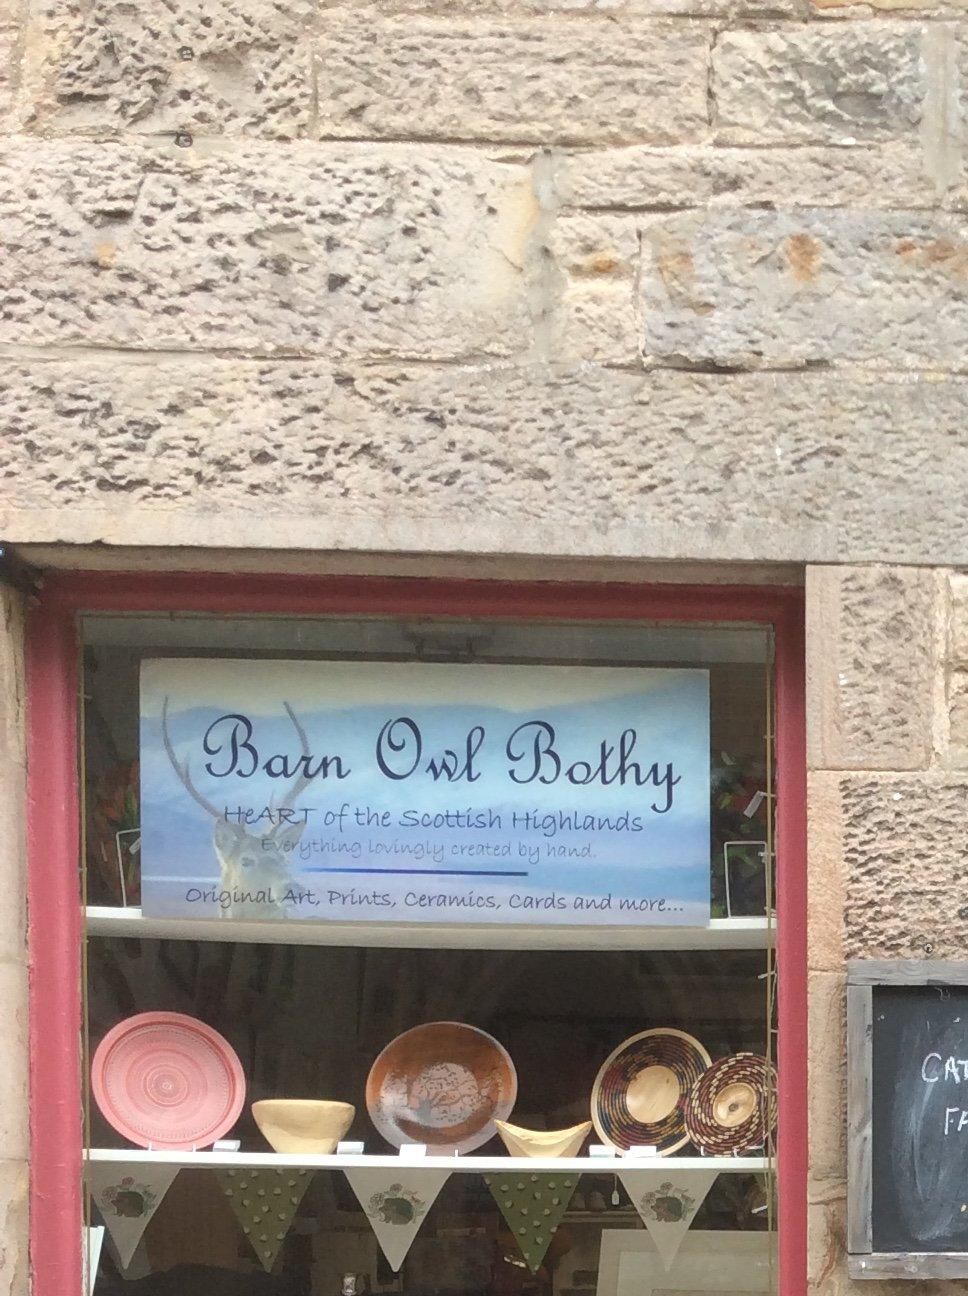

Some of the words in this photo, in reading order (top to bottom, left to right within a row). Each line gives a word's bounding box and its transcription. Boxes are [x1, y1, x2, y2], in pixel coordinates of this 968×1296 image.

[203, 714, 351, 779] Barn
[375, 717, 485, 782] Owl
[506, 720, 681, 813] Bothy
[224, 806, 317, 825] HeART
[324, 803, 350, 832] of
[356, 806, 392, 827] the
[398, 806, 502, 829] Scottish
[512, 808, 644, 837] Highlands
[261, 838, 362, 860] Everything
[368, 839, 445, 862] lovingly
[451, 841, 511, 857] created
[518, 841, 540, 864] by
[547, 843, 597, 858] hand.
[185, 886, 272, 909] Original
[280, 888, 321, 906] Art,
[327, 888, 397, 908] Prints,
[405, 891, 501, 909] Ceramics,
[509, 892, 567, 910] Cards
[573, 893, 612, 911] and
[619, 898, 684, 912] more...
